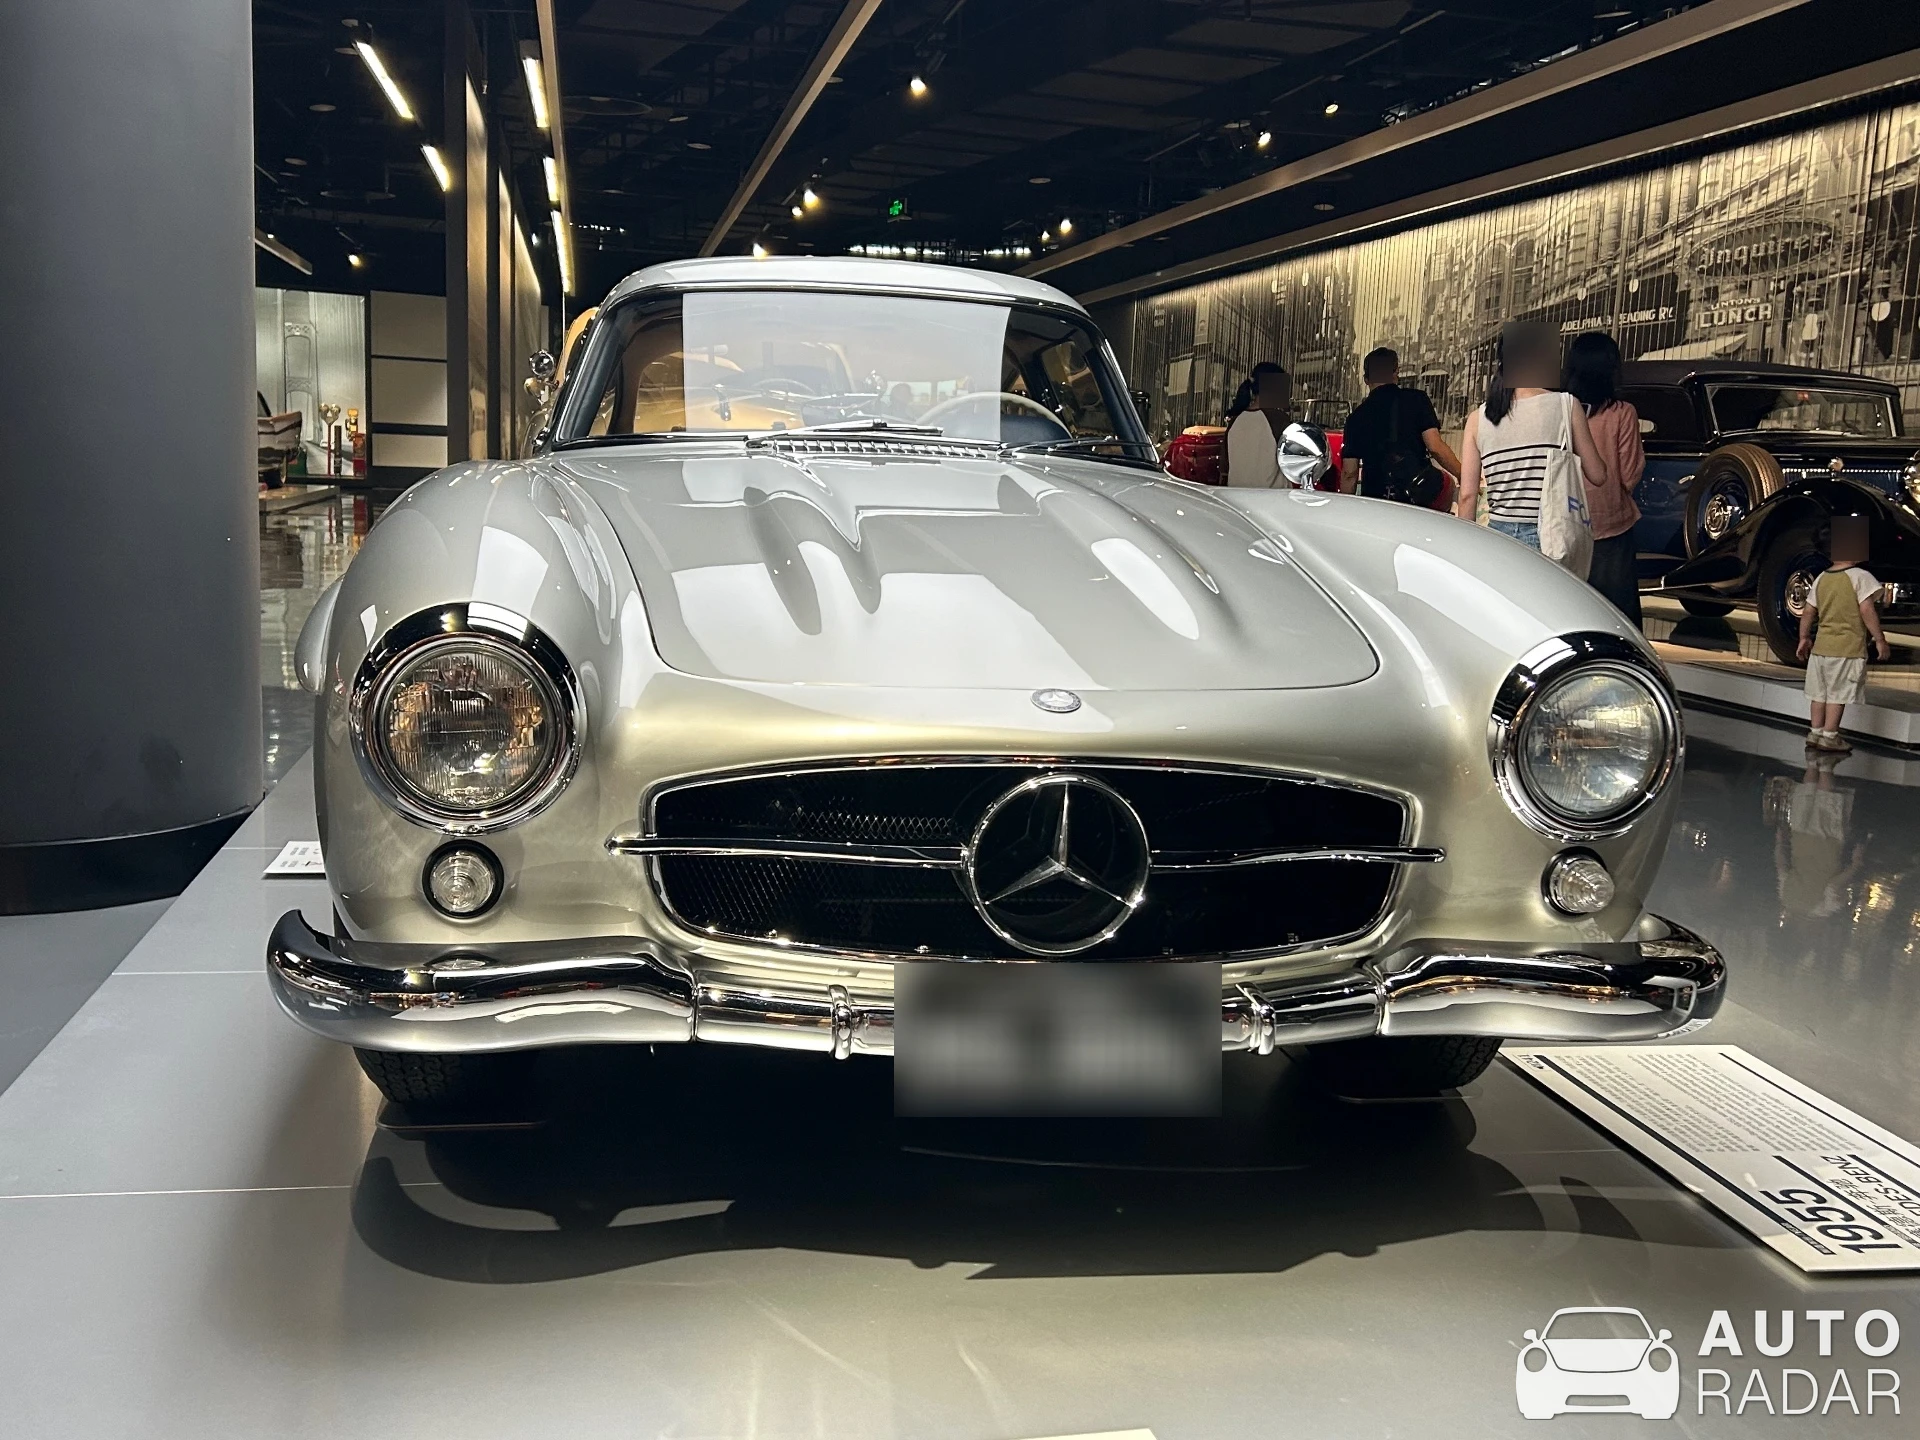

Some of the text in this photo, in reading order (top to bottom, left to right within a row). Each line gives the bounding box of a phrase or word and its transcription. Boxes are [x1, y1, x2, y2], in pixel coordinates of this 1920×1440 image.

[1560, 316, 1603, 332] ADELPHIA
[1699, 303, 1772, 329] LUNCH
[1758, 1188, 1903, 1254] 1955
